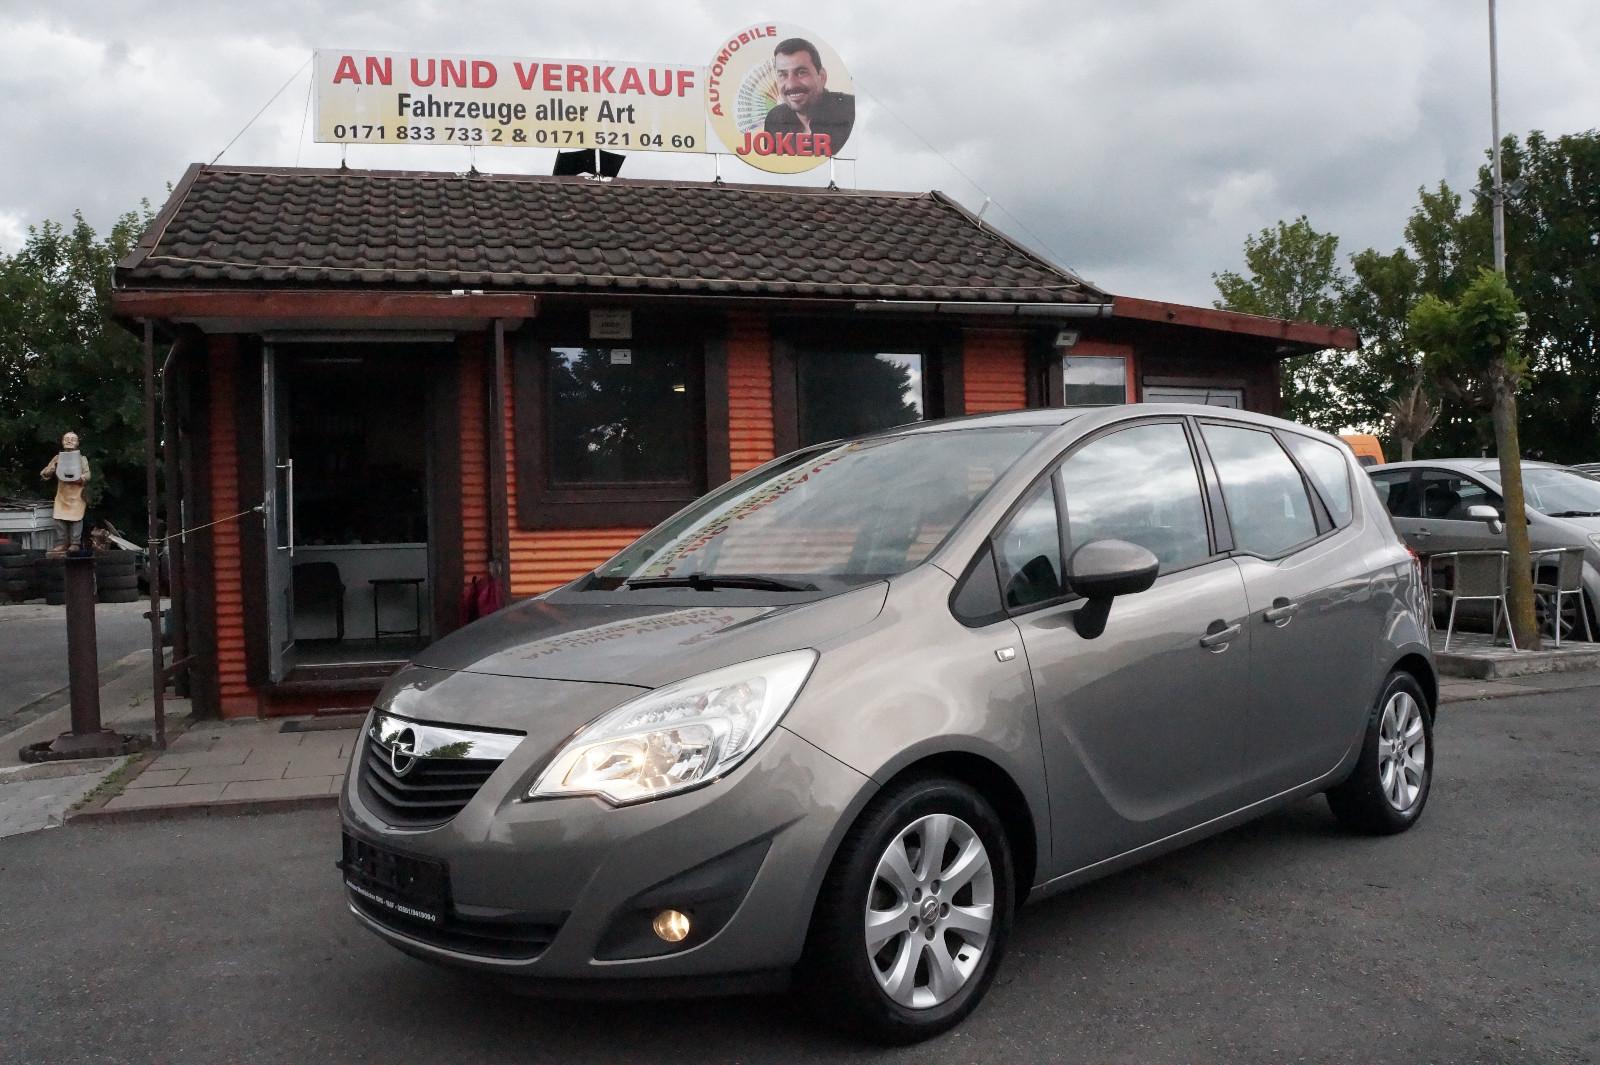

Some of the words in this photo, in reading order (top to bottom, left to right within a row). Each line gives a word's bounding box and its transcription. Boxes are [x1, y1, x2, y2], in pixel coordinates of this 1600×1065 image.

[333, 55, 393, 85] AN
[409, 58, 498, 89] UND
[514, 62, 696, 97] VERKAUF
[708, 25, 777, 117] AUTOMOBILE
[397, 93, 527, 124] Fahrzeuge
[535, 98, 589, 122] aller
[597, 101, 636, 125] Art
[333, 124, 387, 140] 0171
[396, 126, 436, 141] 833
[444, 127, 484, 142] 733
[491, 128, 504, 143] 2
[512, 128, 528, 144] &
[535, 129, 586, 145] 0171
[594, 131, 631, 146] 521
[639, 132, 664, 148] 04
[671, 134, 696, 149] 60
[736, 131, 832, 157] JOKER
